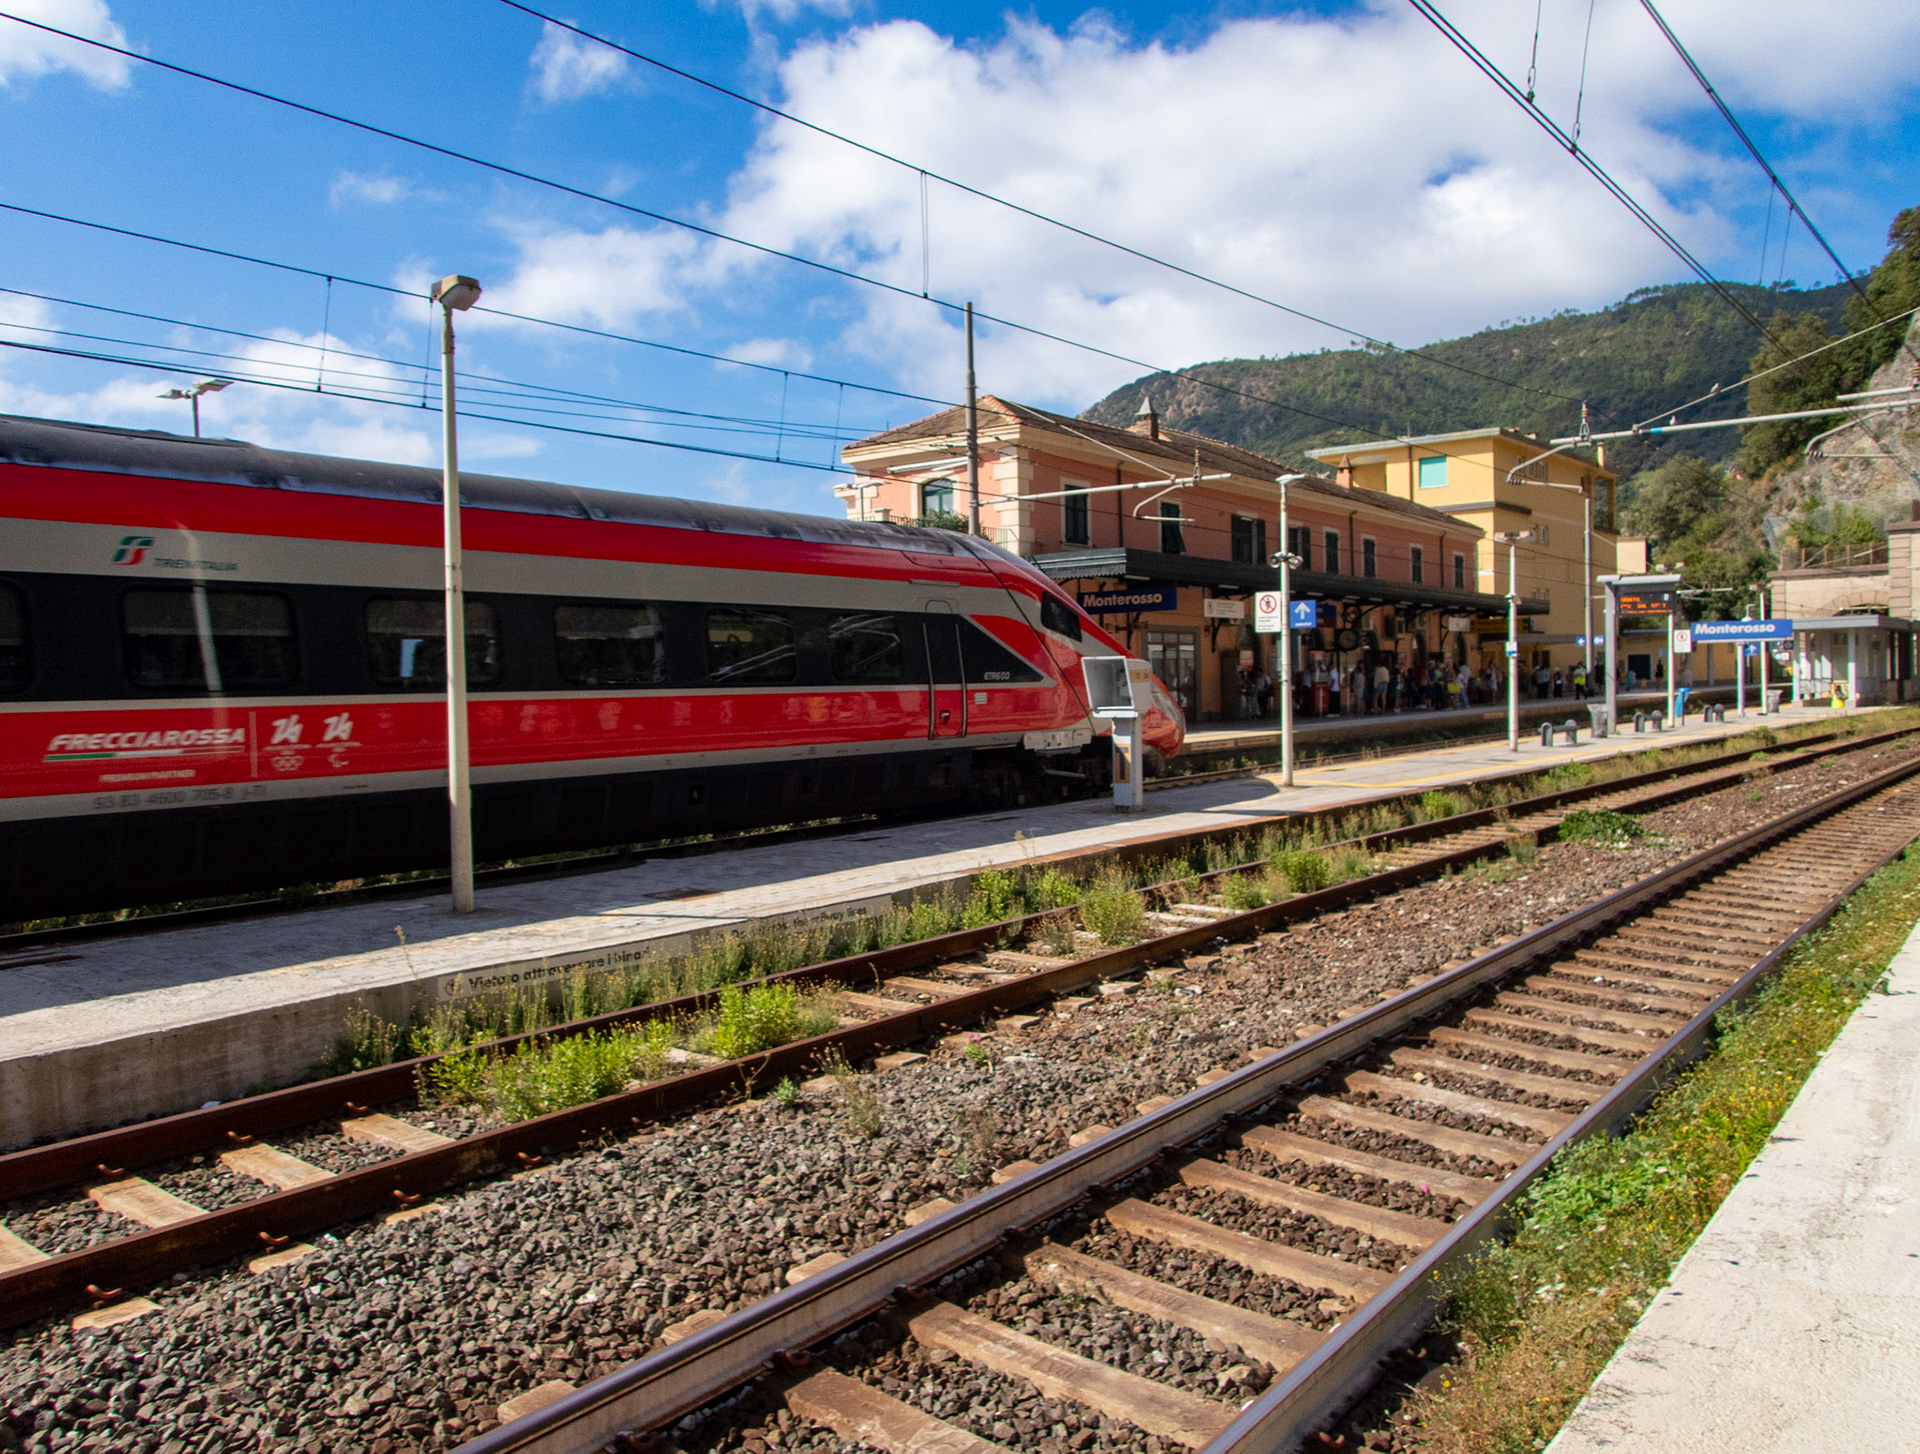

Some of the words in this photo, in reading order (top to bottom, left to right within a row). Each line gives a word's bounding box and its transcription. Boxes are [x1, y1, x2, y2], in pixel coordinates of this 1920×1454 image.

[154, 558, 239, 571] TRENTALIA
[1083, 593, 1163, 608] Monterosso
[1695, 623, 1776, 635] Monterosso
[48, 727, 246, 751] FRECCIAROSSA
[468, 973, 520, 990] Vietao
